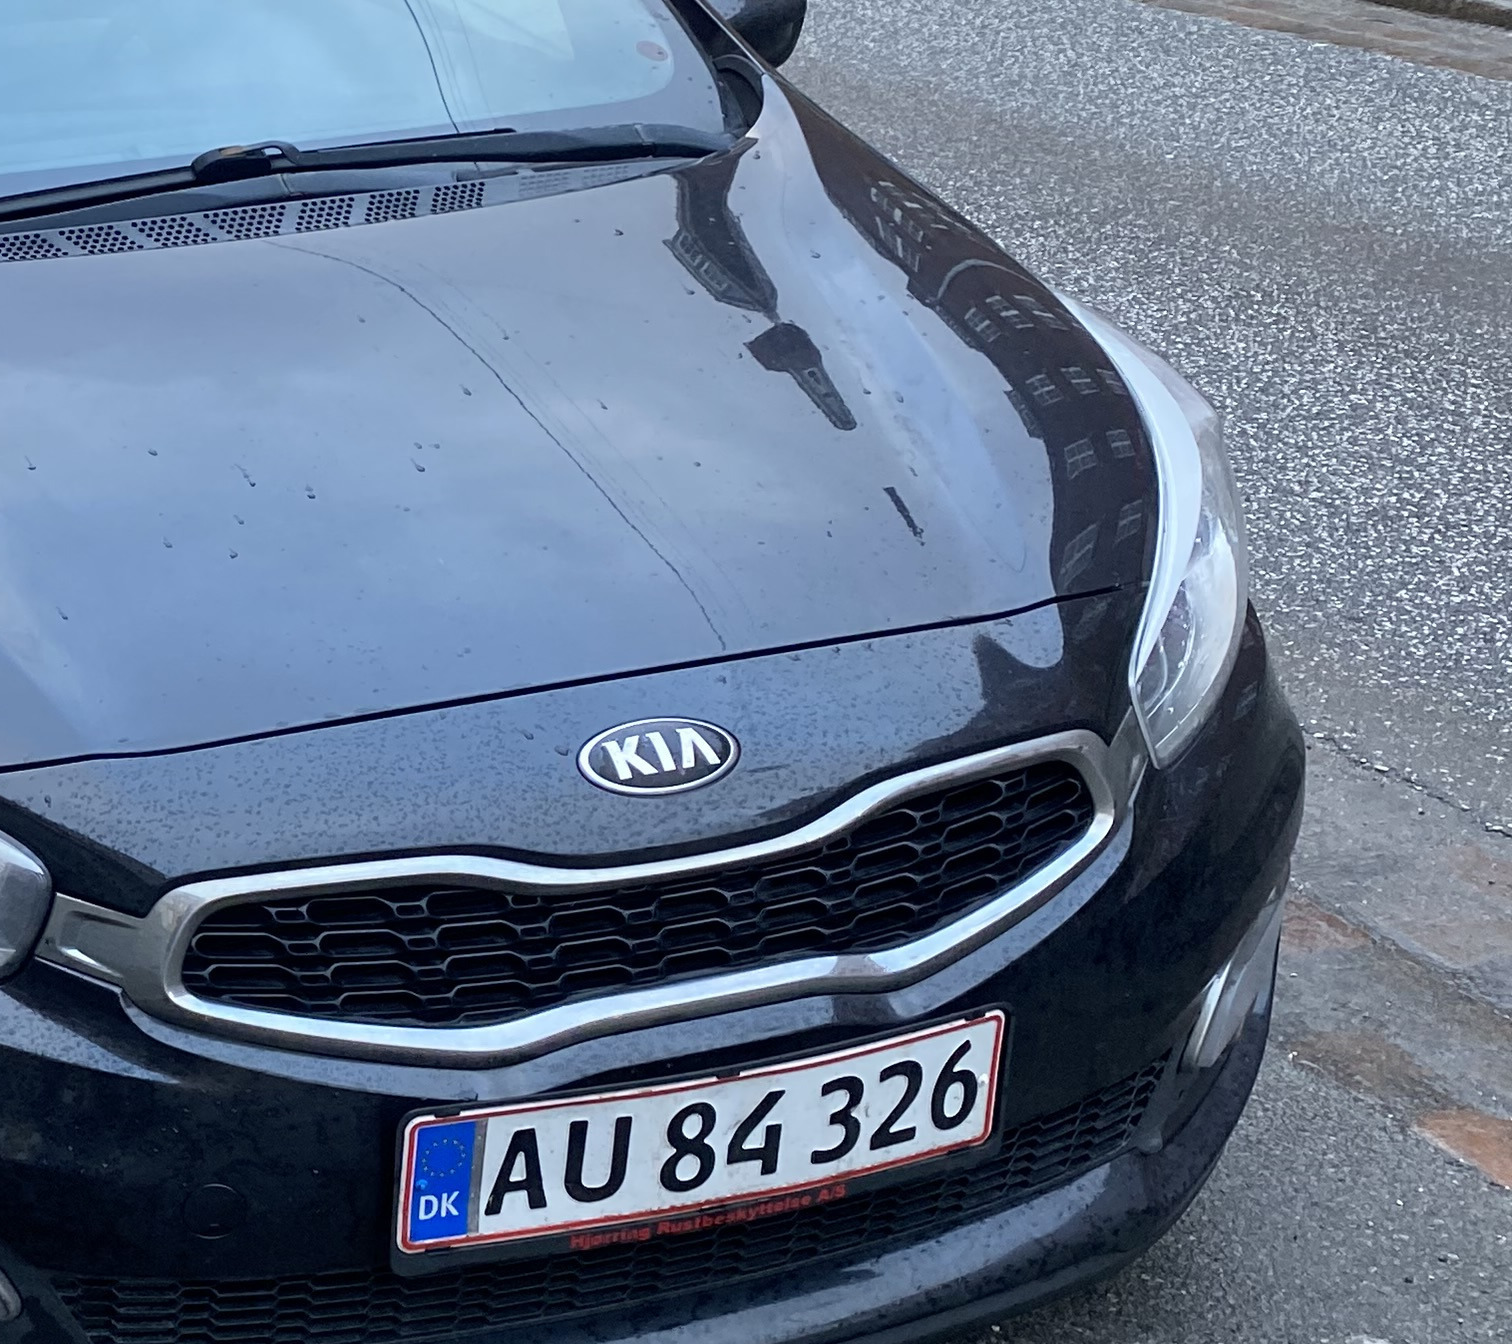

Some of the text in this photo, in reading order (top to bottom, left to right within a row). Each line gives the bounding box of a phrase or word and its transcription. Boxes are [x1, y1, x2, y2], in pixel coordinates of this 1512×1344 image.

[601, 727, 721, 780] KIA
[484, 1040, 979, 1216] AU 84 326
[418, 1190, 461, 1221] DK
[570, 1184, 847, 1250] Hjørring Rustbeskyttelse A/S
